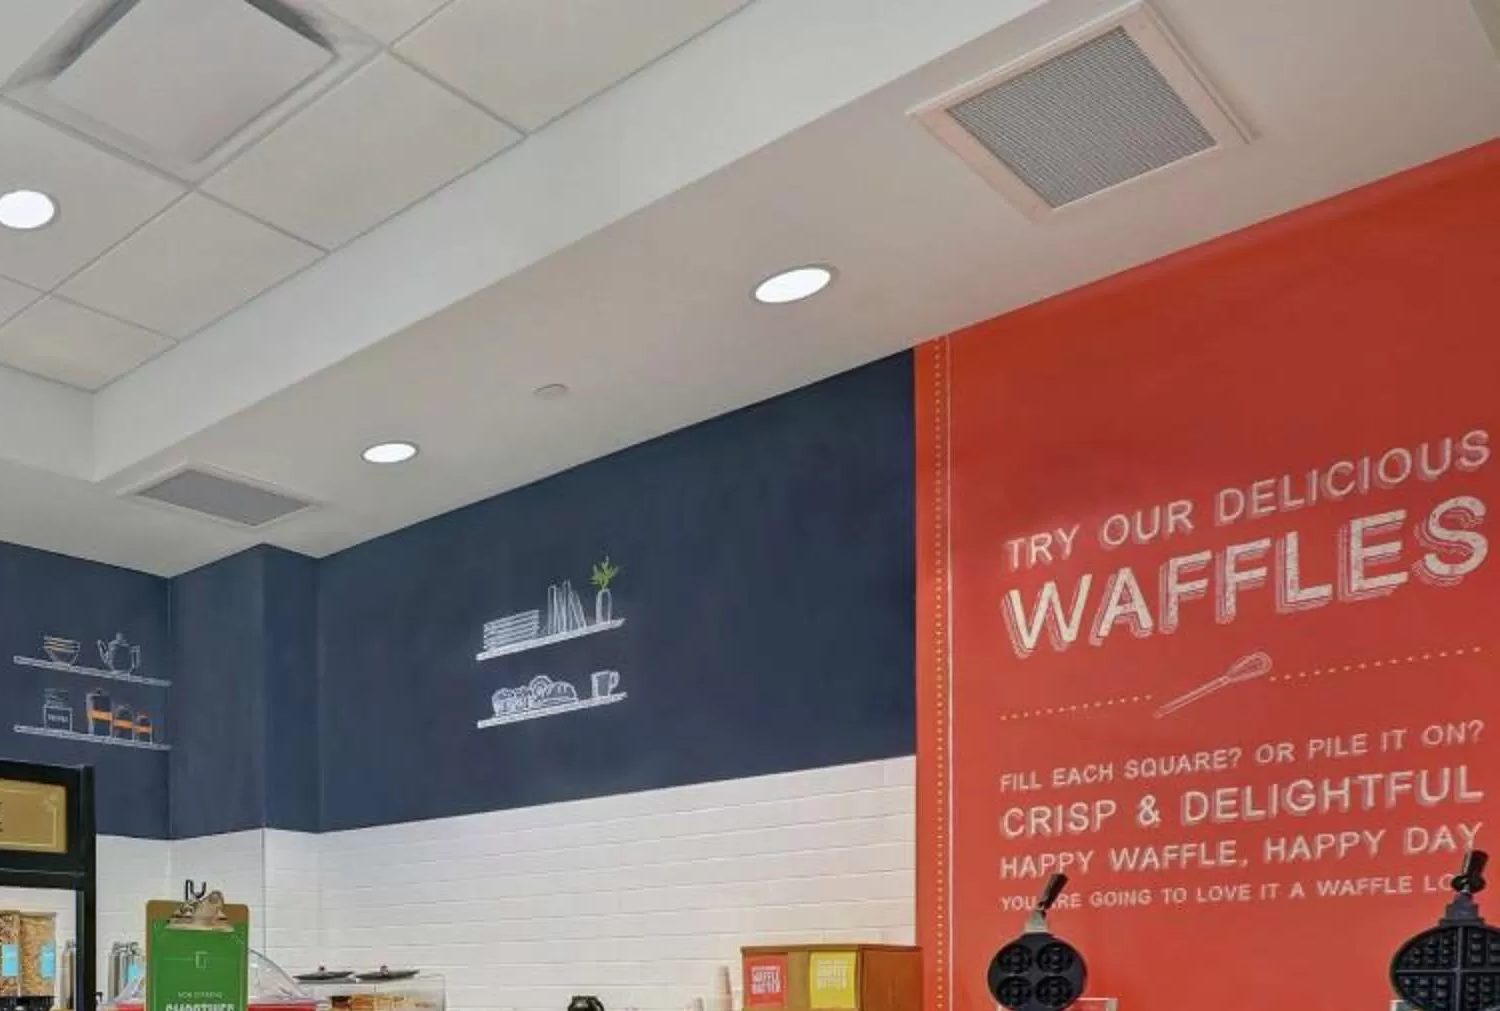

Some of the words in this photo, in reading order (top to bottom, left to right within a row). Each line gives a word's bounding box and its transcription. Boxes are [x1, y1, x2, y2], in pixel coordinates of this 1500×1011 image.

[1004, 524, 1080, 571] TRY
[1099, 500, 1195, 548] OUR
[1214, 429, 1490, 526] DELICIOUS
[1002, 496, 1489, 659] WAFFLES
[1001, 772, 1042, 793] FILL
[1052, 763, 1114, 788] EACH
[1124, 748, 1243, 781] SQUARE?
[1255, 742, 1295, 765] OR
[1307, 732, 1369, 759] PILE
[1380, 729, 1407, 752] IT
[1421, 719, 1485, 747] ON?
[1002, 799, 1118, 839] CRISP
[1138, 795, 1162, 827] &
[1181, 765, 1486, 826] DELIGHTFUL
[1001, 850, 1094, 879] HAPPY
[1109, 840, 1249, 872] WAFFLE,
[1264, 829, 1387, 864] HAPPY
[1403, 822, 1483, 855] DAY
[1000, 895, 1040, 912] YOU
[1051, 892, 1083, 911] RE
[1090, 887, 1152, 909] GOING
[1162, 886, 1188, 905] TO
[1196, 883, 1254, 904] LOVE
[1260, 882, 1280, 900] IT
[1291, 880, 1306, 899] A
[1317, 875, 1414, 898] WAFFLE
